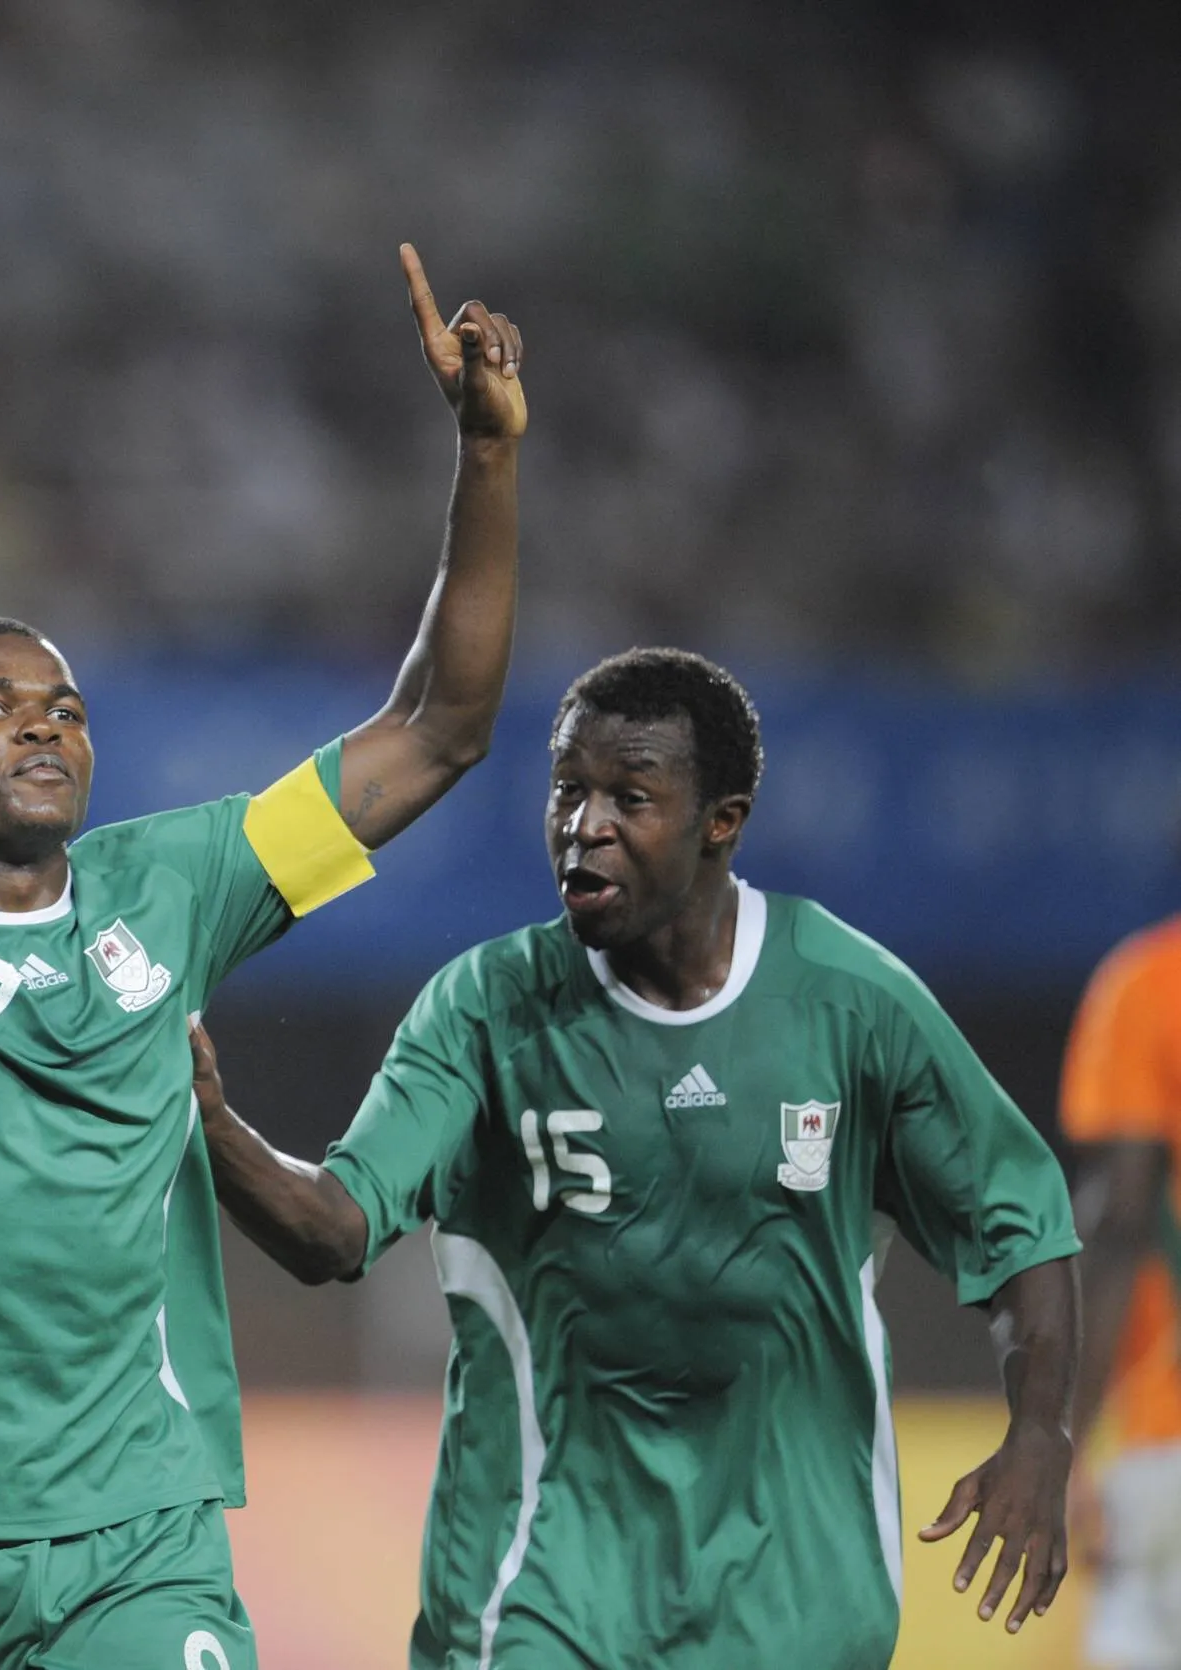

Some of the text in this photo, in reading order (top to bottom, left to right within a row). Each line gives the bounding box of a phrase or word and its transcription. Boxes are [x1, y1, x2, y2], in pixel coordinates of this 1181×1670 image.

[22, 971, 69, 990] didas
[665, 1092, 727, 1109] adidas
[520, 1108, 612, 1214] 15
